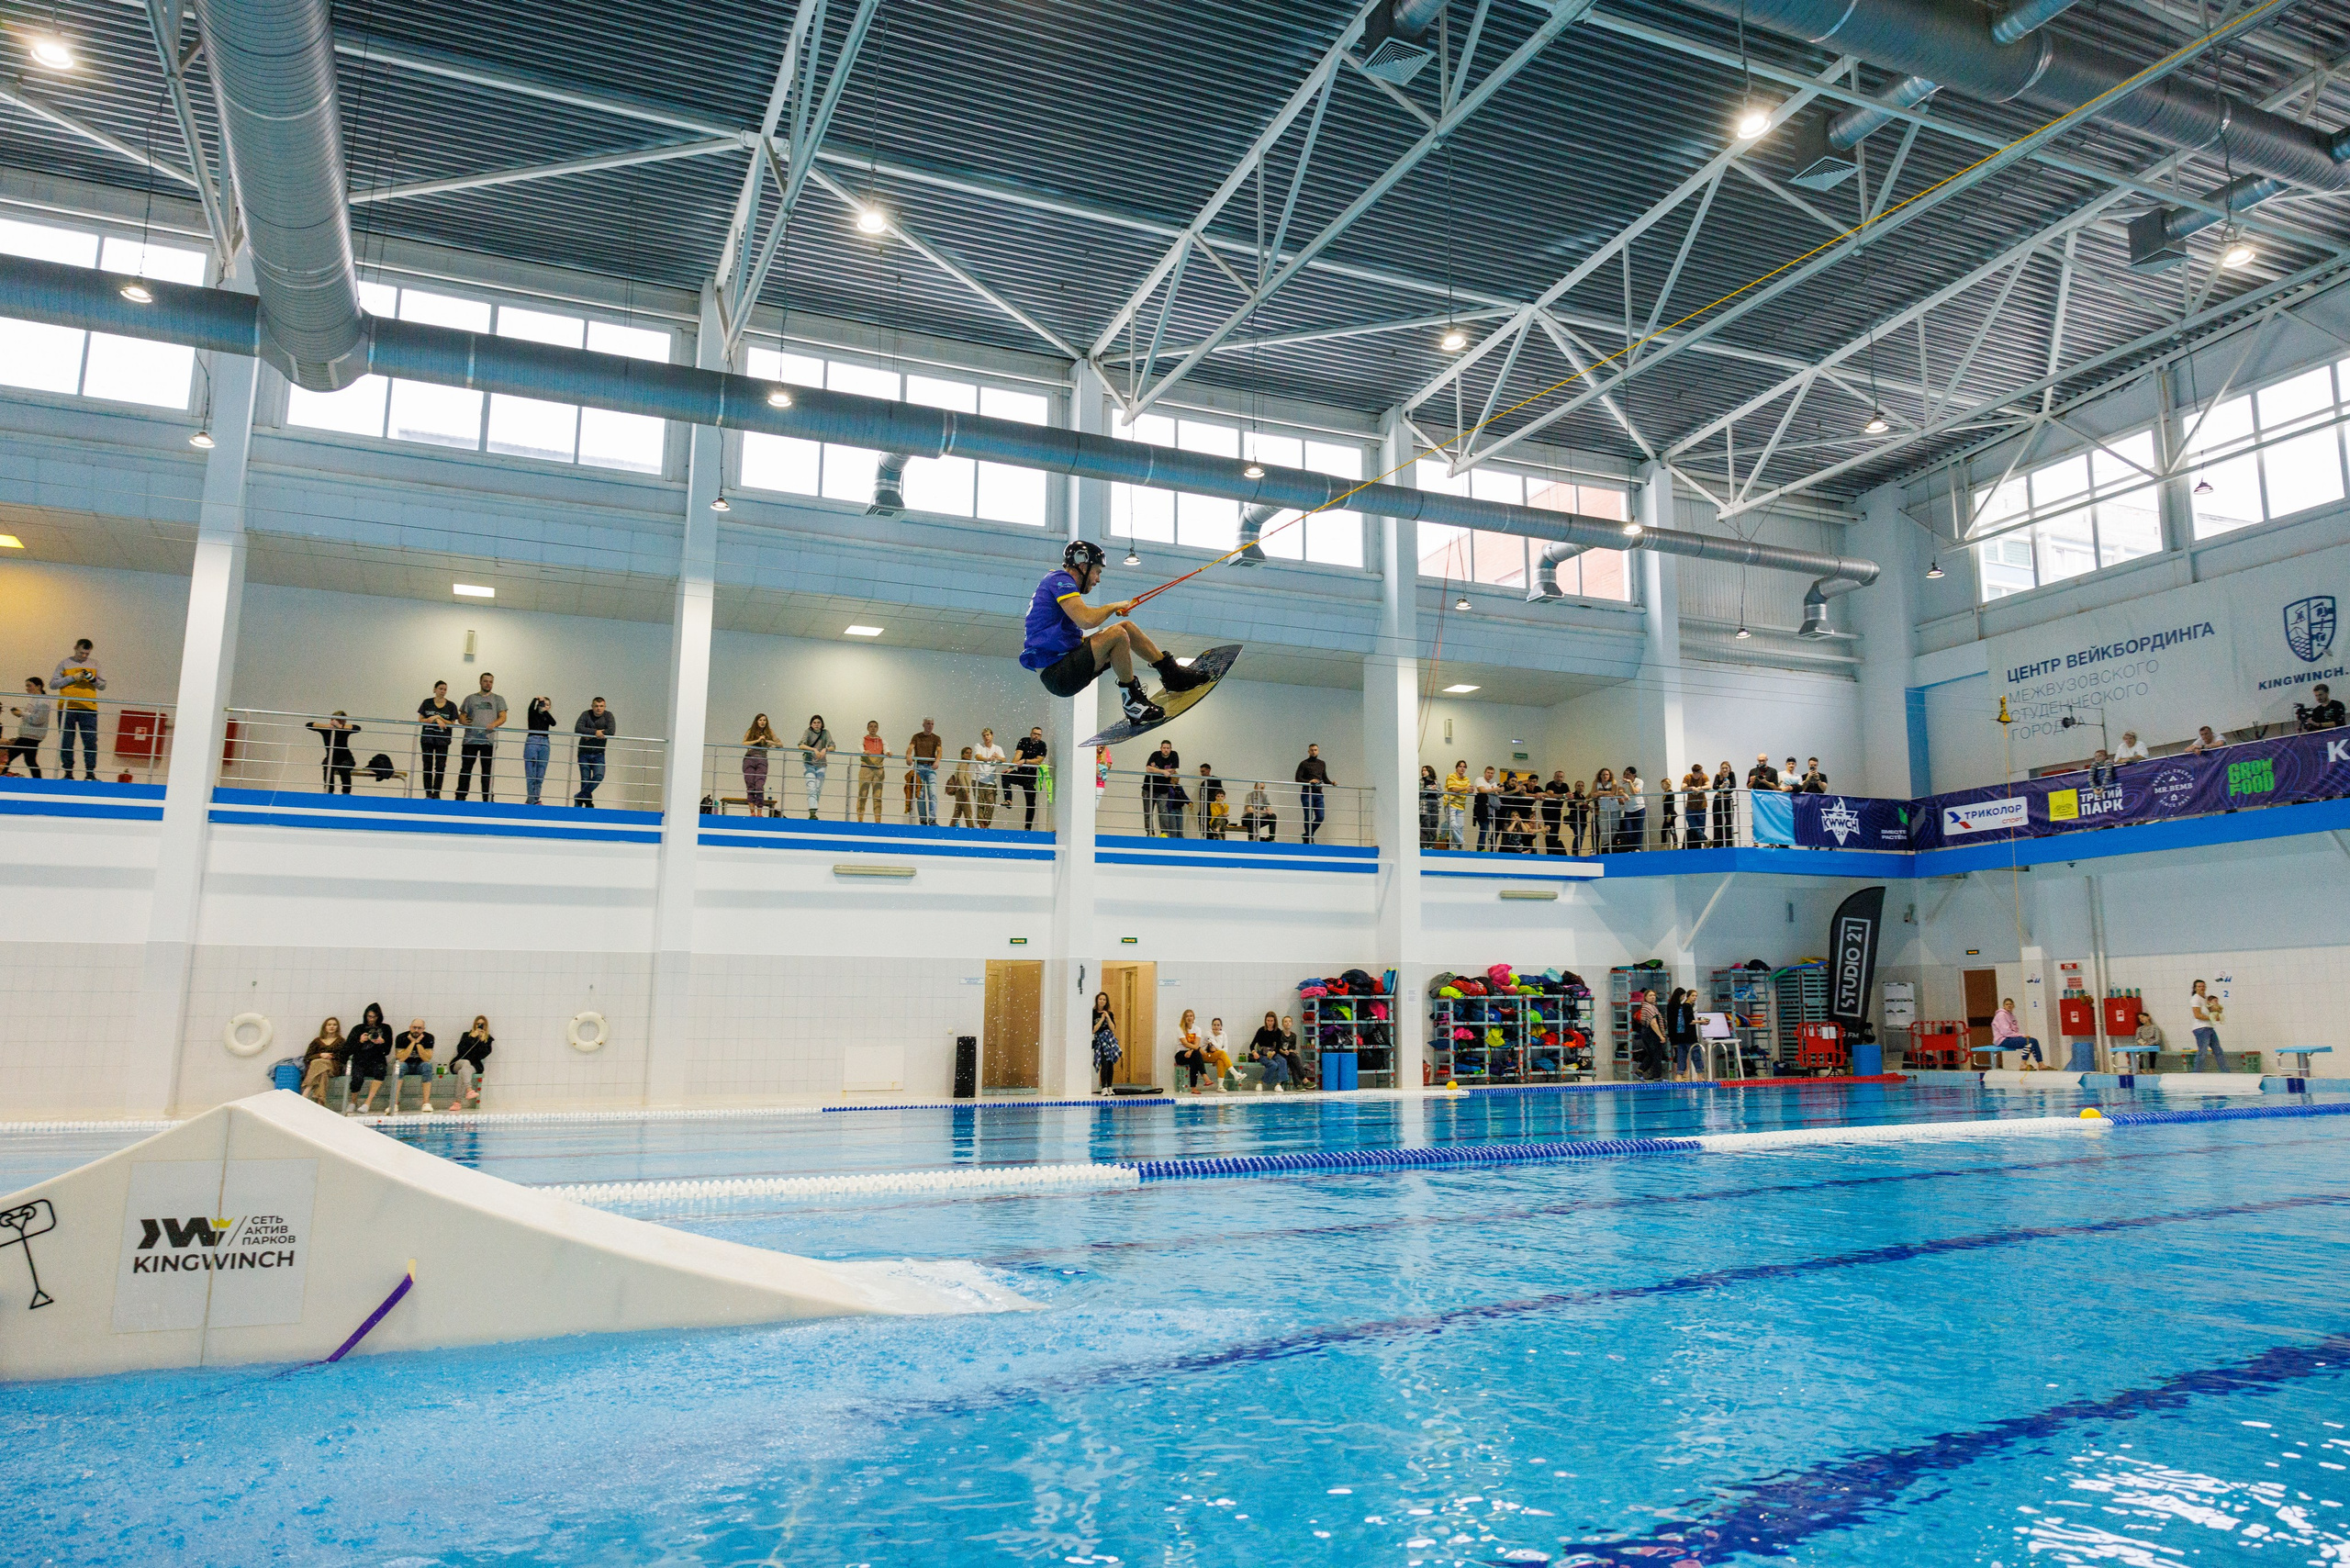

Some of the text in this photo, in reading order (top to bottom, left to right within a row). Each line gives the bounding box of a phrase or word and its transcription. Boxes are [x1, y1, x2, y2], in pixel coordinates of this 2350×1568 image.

[2008, 622, 2215, 683] ЦЕНТР ВЕЙКБОРДИНГА
[2009, 659, 2159, 704] МЕЖВУЗОВСКОГО
[2010, 682, 2148, 723] СТУДЕНЧЕСКОГО
[2011, 716, 2087, 741] ГОРОДА
[2228, 757, 2273, 783] GROW
[2154, 783, 2193, 793] MR.BEMB
[2229, 771, 2275, 796] FOOD
[1964, 804, 2022, 820] ТРИКОЛОР
[2081, 799, 2124, 815] ПАРК
[1823, 818, 1859, 833] KWWCH
[1846, 925, 1863, 944] 21
[1841, 947, 1861, 1008] STUDIO
[2223, 990, 2230, 998] 2
[251, 1215, 284, 1225] СЕТЬ
[244, 1226, 288, 1235] АКТИВ
[241, 1235, 297, 1246] ПАРКОВ
[133, 1249, 295, 1273] KINGWINCH
